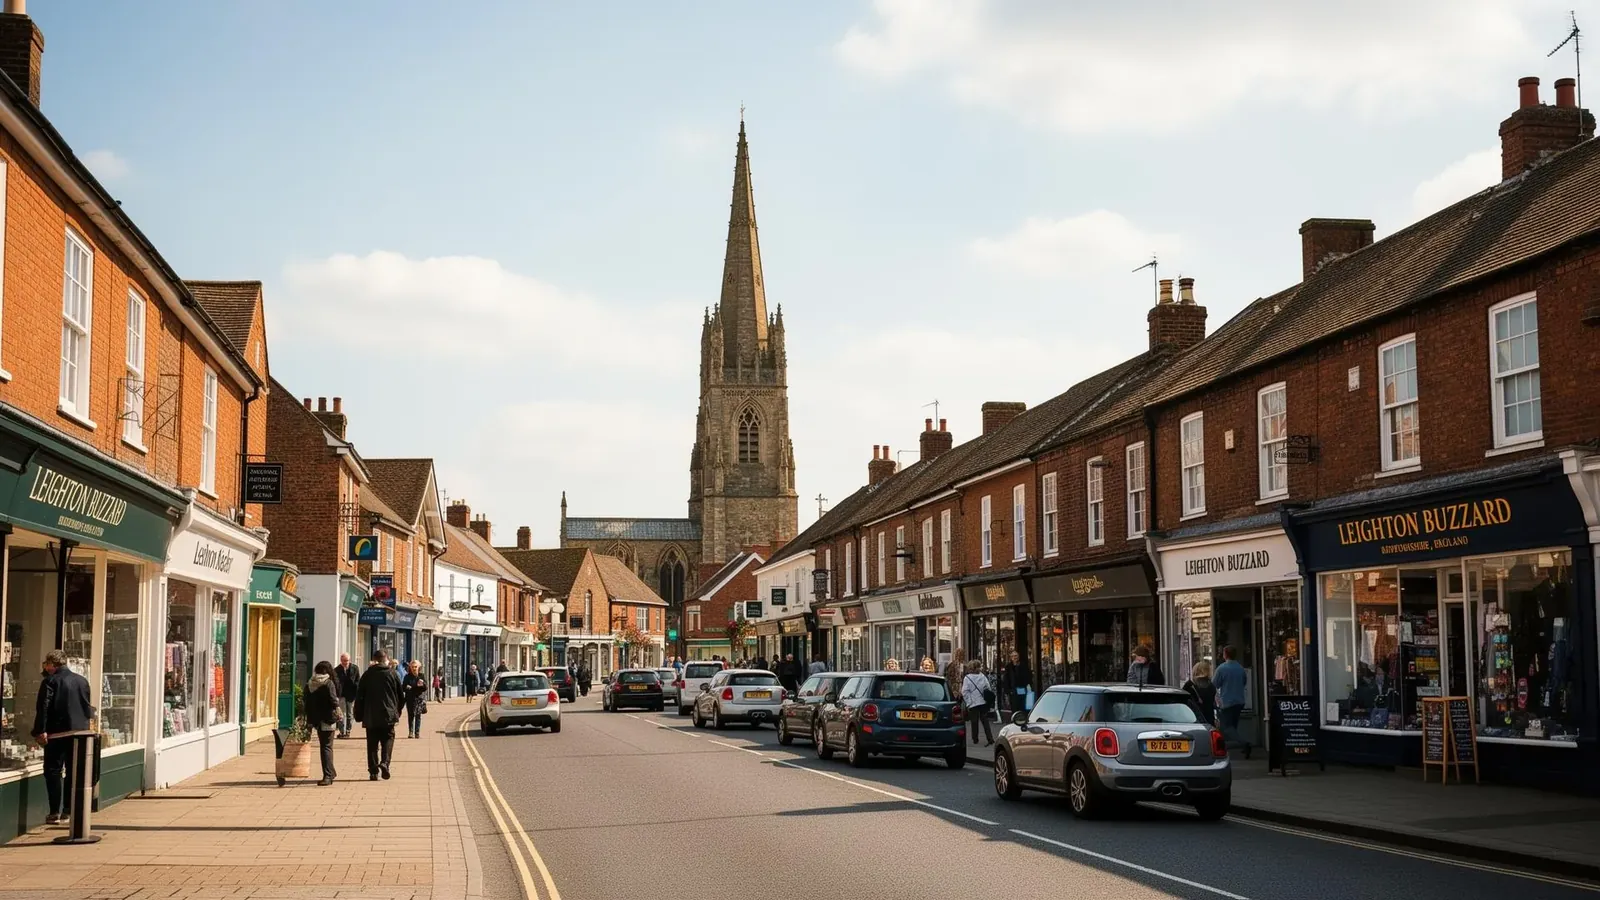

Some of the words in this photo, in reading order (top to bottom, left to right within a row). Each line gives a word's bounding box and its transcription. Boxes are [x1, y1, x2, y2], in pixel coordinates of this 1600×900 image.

[29, 466, 92, 515] LEIGHTON
[86, 489, 127, 526] BUZZARD
[1338, 511, 1419, 545] LEIGHTON
[1422, 498, 1511, 533] BUZZARD
[1185, 556, 1224, 576] LEIGHTON
[1227, 550, 1269, 571] BUZZARD
